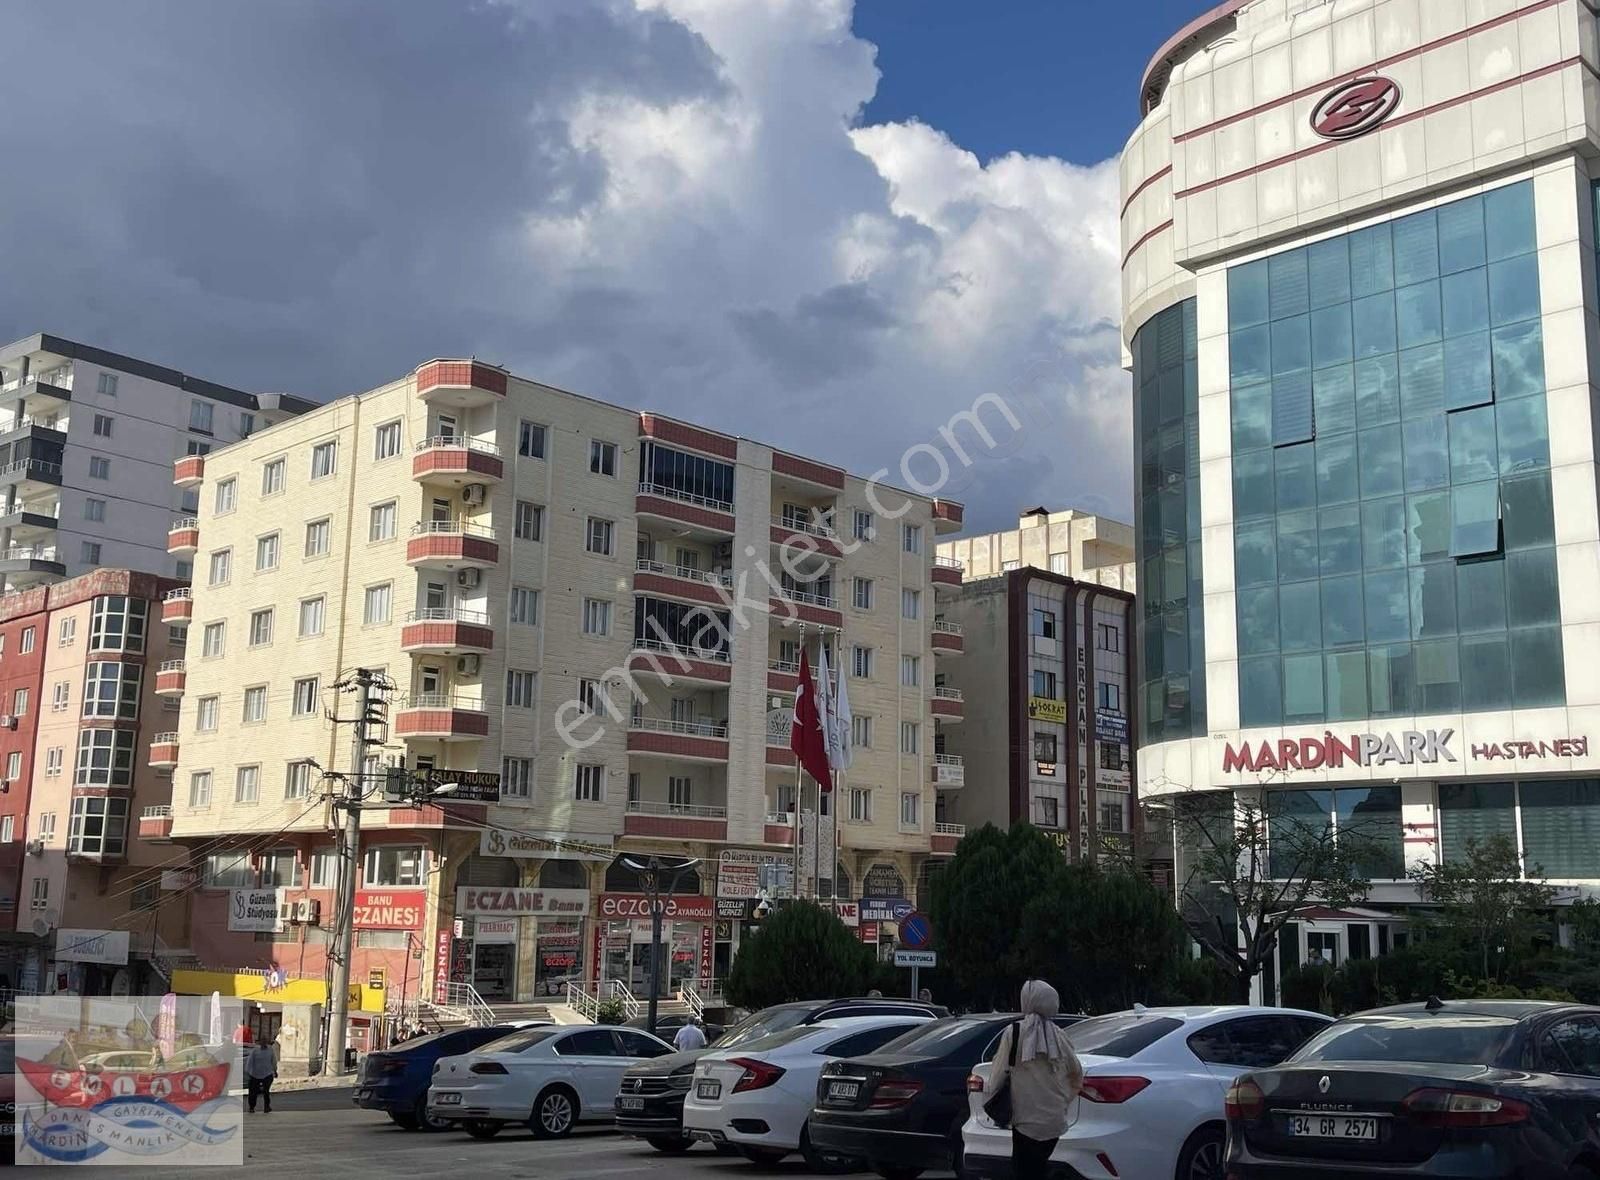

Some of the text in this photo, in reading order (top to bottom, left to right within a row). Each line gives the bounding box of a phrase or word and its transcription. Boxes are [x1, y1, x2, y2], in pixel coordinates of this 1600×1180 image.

[1077, 647, 1087, 745] ERCAN
[1471, 735, 1588, 761] HASTANESİ
[464, 772, 499, 787] HUKUK
[249, 893, 276, 905] Güzellik
[368, 895, 393, 906] BANU
[466, 888, 544, 912] ECZANE
[602, 897, 713, 917] eczane AYANOĞLU
[246, 907, 278, 920] Stüdyosu
[352, 907, 419, 926] CZANESİ
[479, 921, 515, 933] PHARMACY
[701, 929, 711, 989] ECZANE
[897, 954, 908, 963] YOL
[437, 933, 448, 1005] ECZANE
[1300, 1103, 1353, 1111] FLUENCE
[1295, 1118, 1375, 1138] 34 GR 2571
